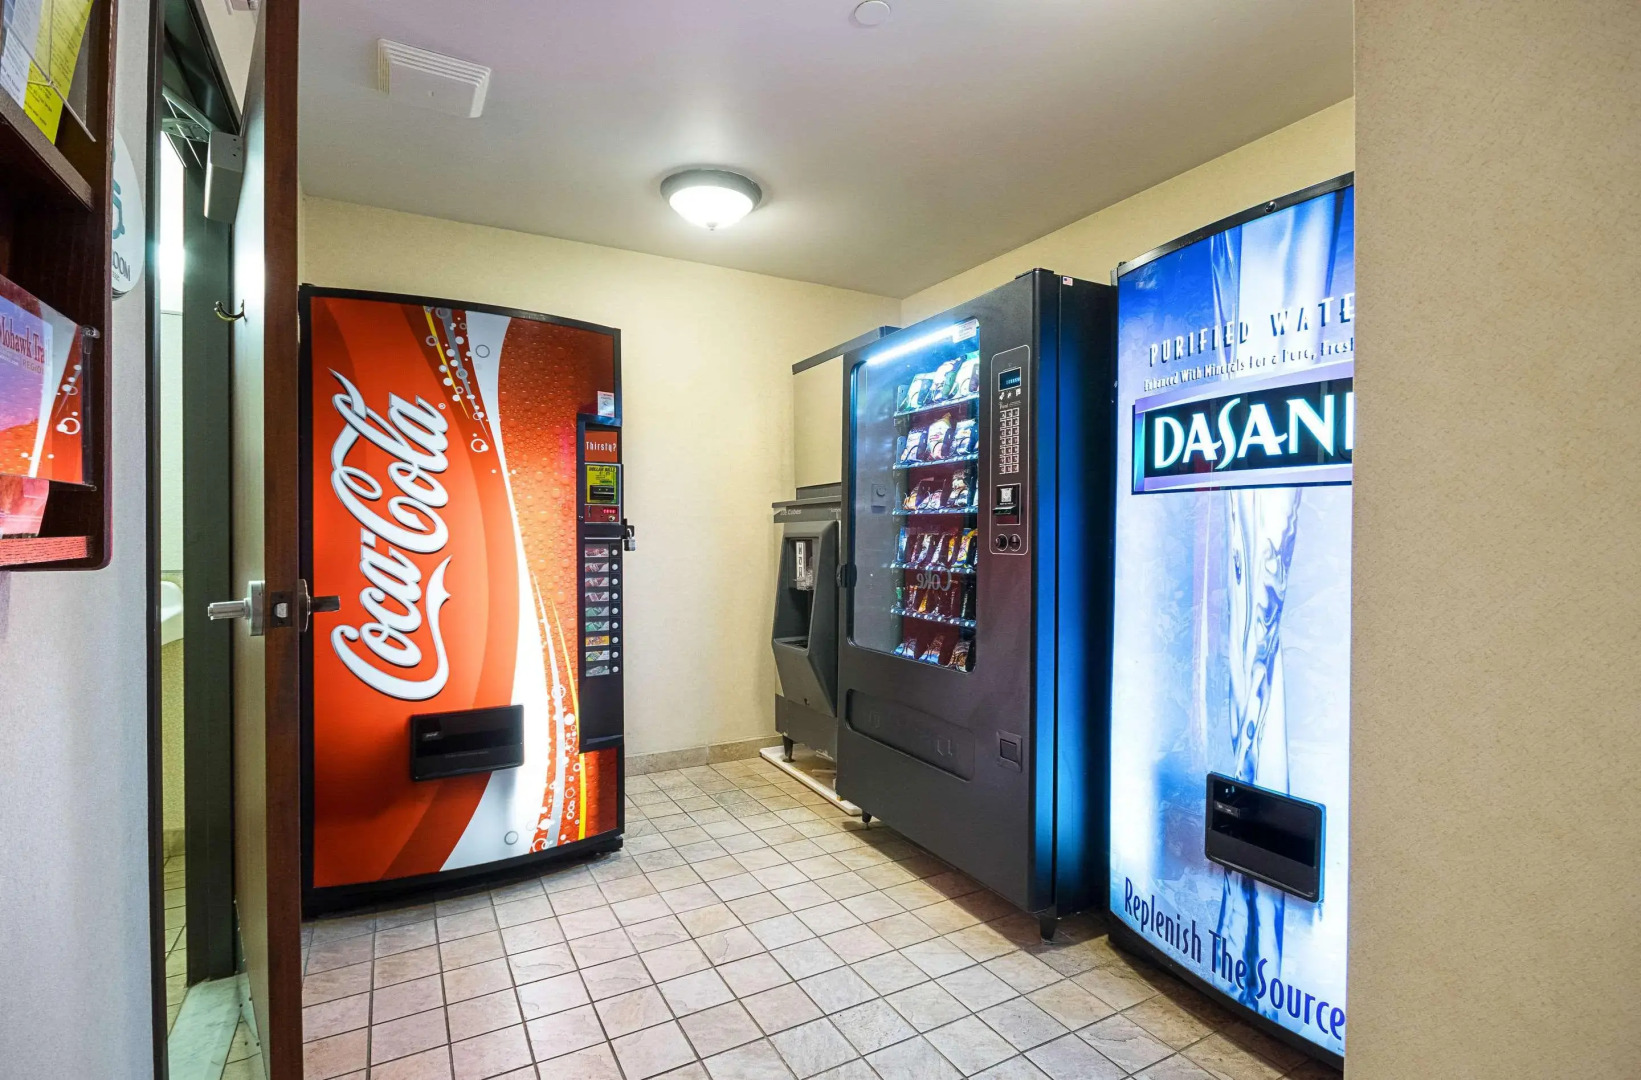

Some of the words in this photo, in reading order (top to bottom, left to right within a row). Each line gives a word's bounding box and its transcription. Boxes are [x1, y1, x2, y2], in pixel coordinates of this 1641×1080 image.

[112, 250, 131, 282] OOM
[1149, 320, 1249, 367] PURIFIED
[1180, 366, 1202, 383] With
[1203, 358, 1245, 378] Minerals
[585, 441, 617, 453] Thirsty?
[329, 367, 452, 701] Coca-Cola
[1124, 876, 1202, 964] Replenish
[1208, 929, 1248, 991] The
[1255, 957, 1346, 1041] Source
